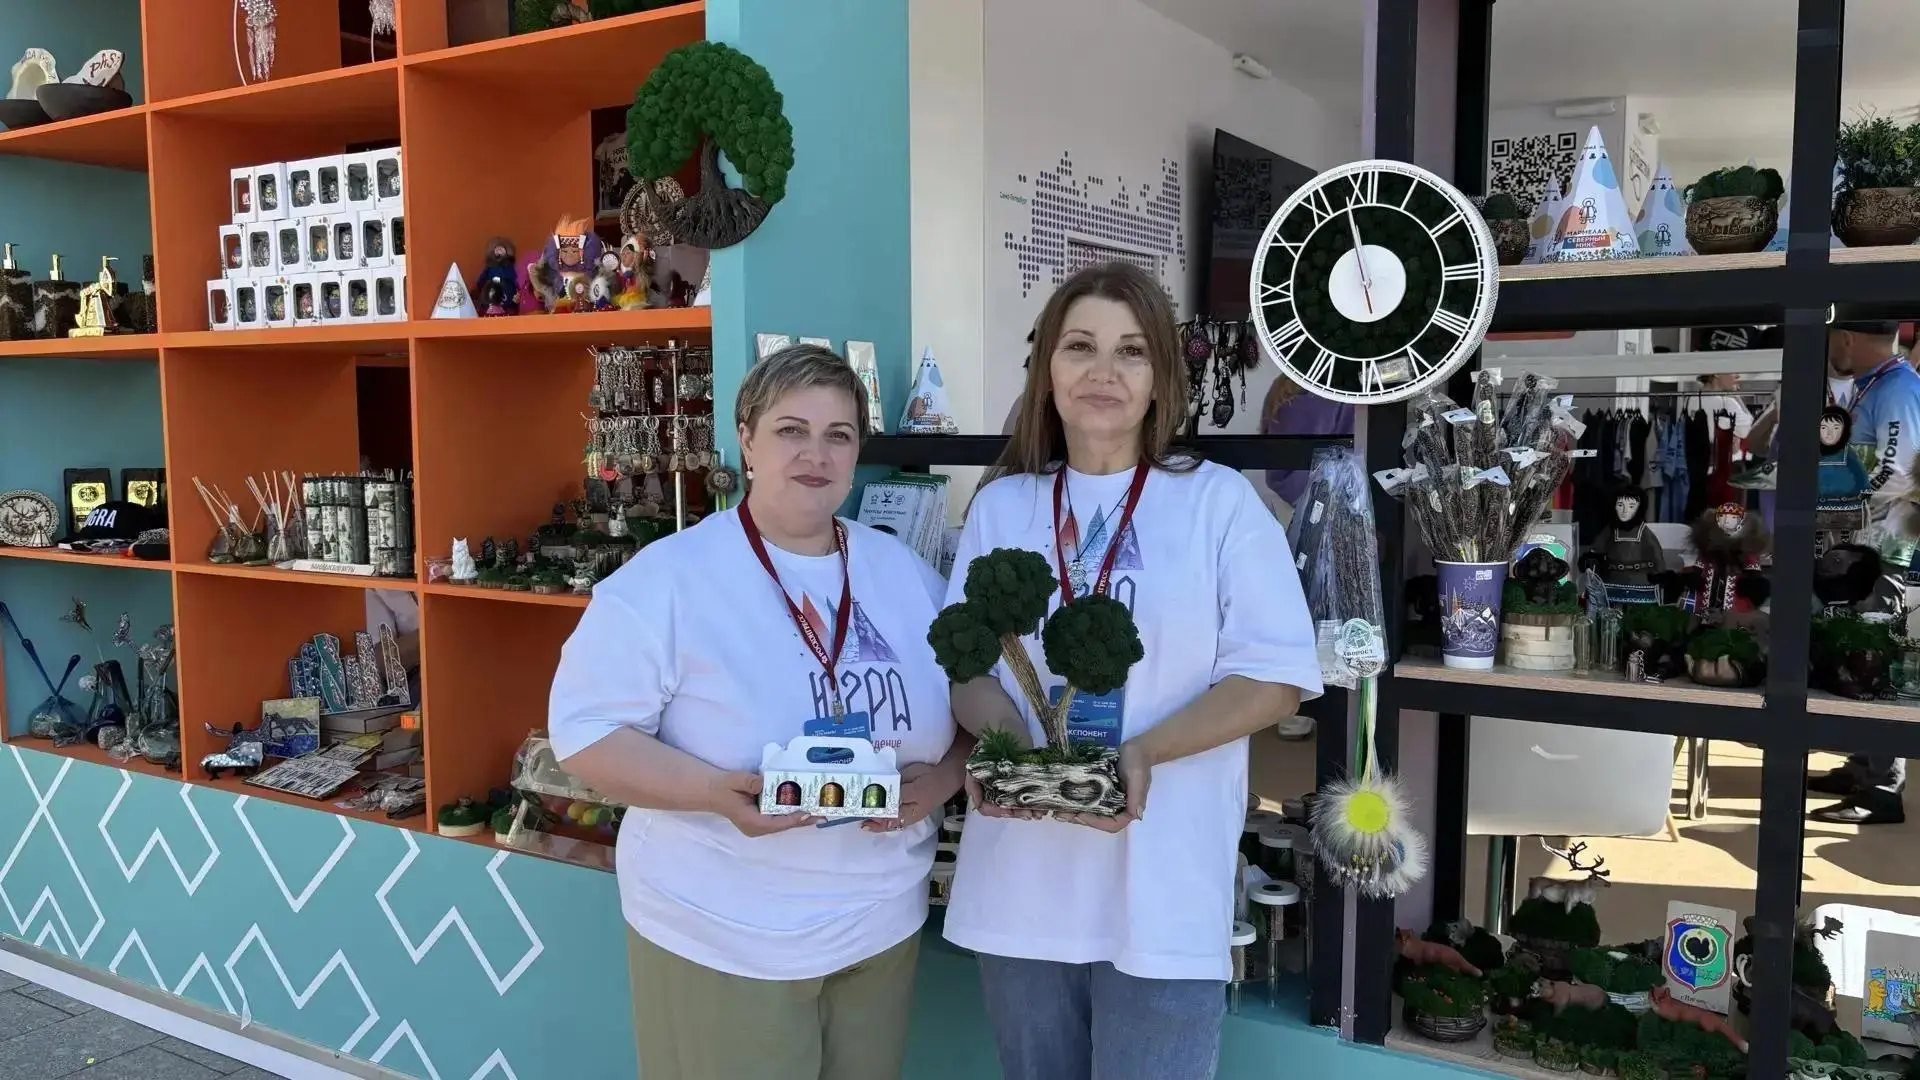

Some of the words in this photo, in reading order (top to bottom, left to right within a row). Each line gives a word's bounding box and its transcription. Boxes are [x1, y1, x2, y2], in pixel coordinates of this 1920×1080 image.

[1567, 235, 1606, 243] СЕВЕРНЫЙ
[1067, 729, 1108, 738] КСПОНЕНТ
[873, 739, 902, 750] дение
